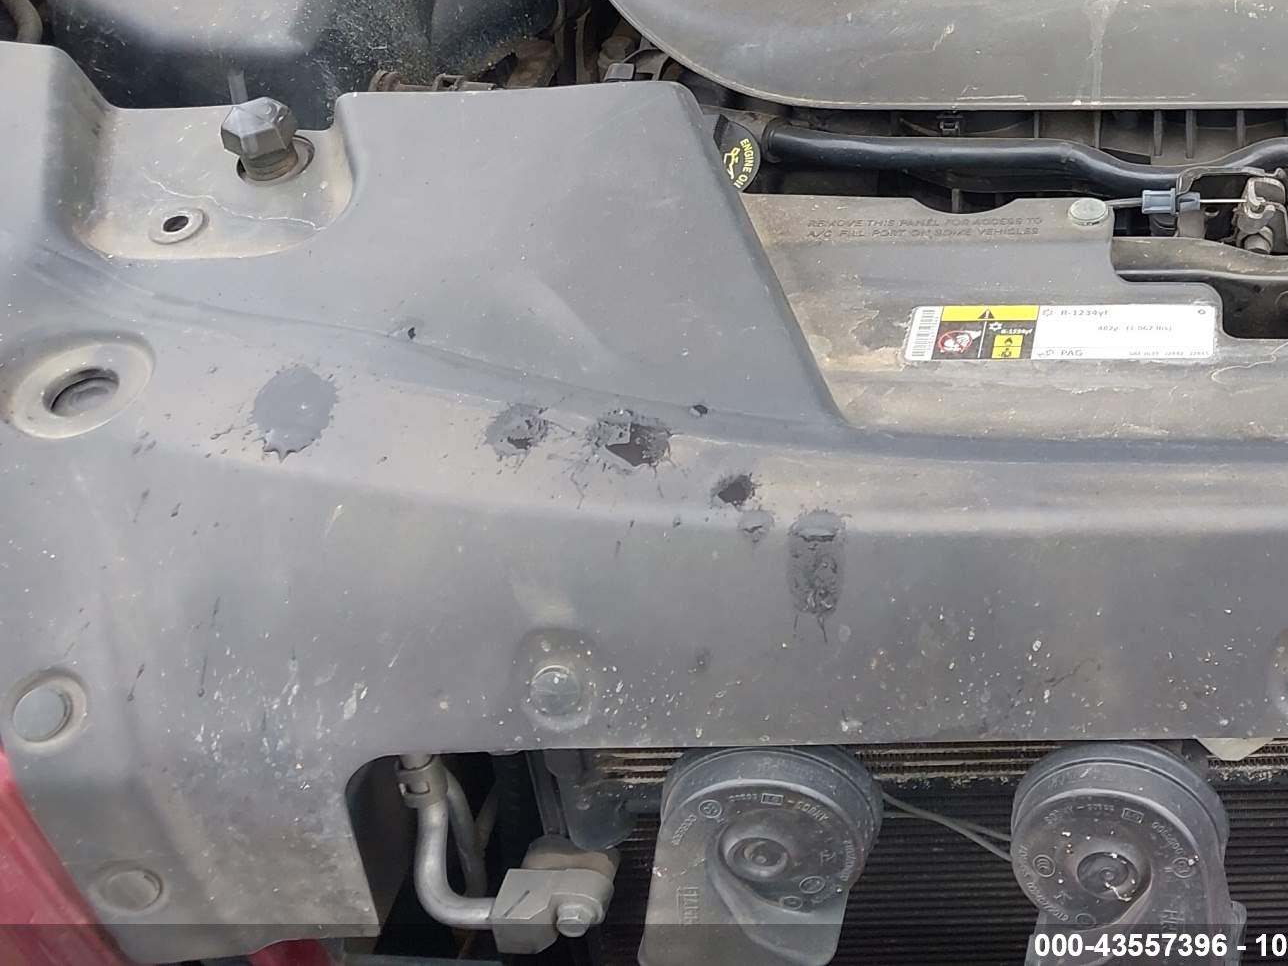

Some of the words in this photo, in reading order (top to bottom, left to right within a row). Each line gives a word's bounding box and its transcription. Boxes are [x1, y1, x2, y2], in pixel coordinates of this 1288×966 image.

[739, 138, 754, 173] ENGINE
[733, 174, 748, 188] OIL
[866, 219, 895, 227] THIS
[899, 218, 941, 227] PANEL
[944, 218, 970, 226] FOR
[973, 218, 1024, 226] ACCESS
[1026, 217, 1042, 225] TO
[807, 229, 832, 238] A/C
[839, 229, 865, 237] FILL
[871, 229, 906, 237] PORT
[977, 227, 1039, 236] VEHICLES
[1060, 349, 1084, 357] PAG
